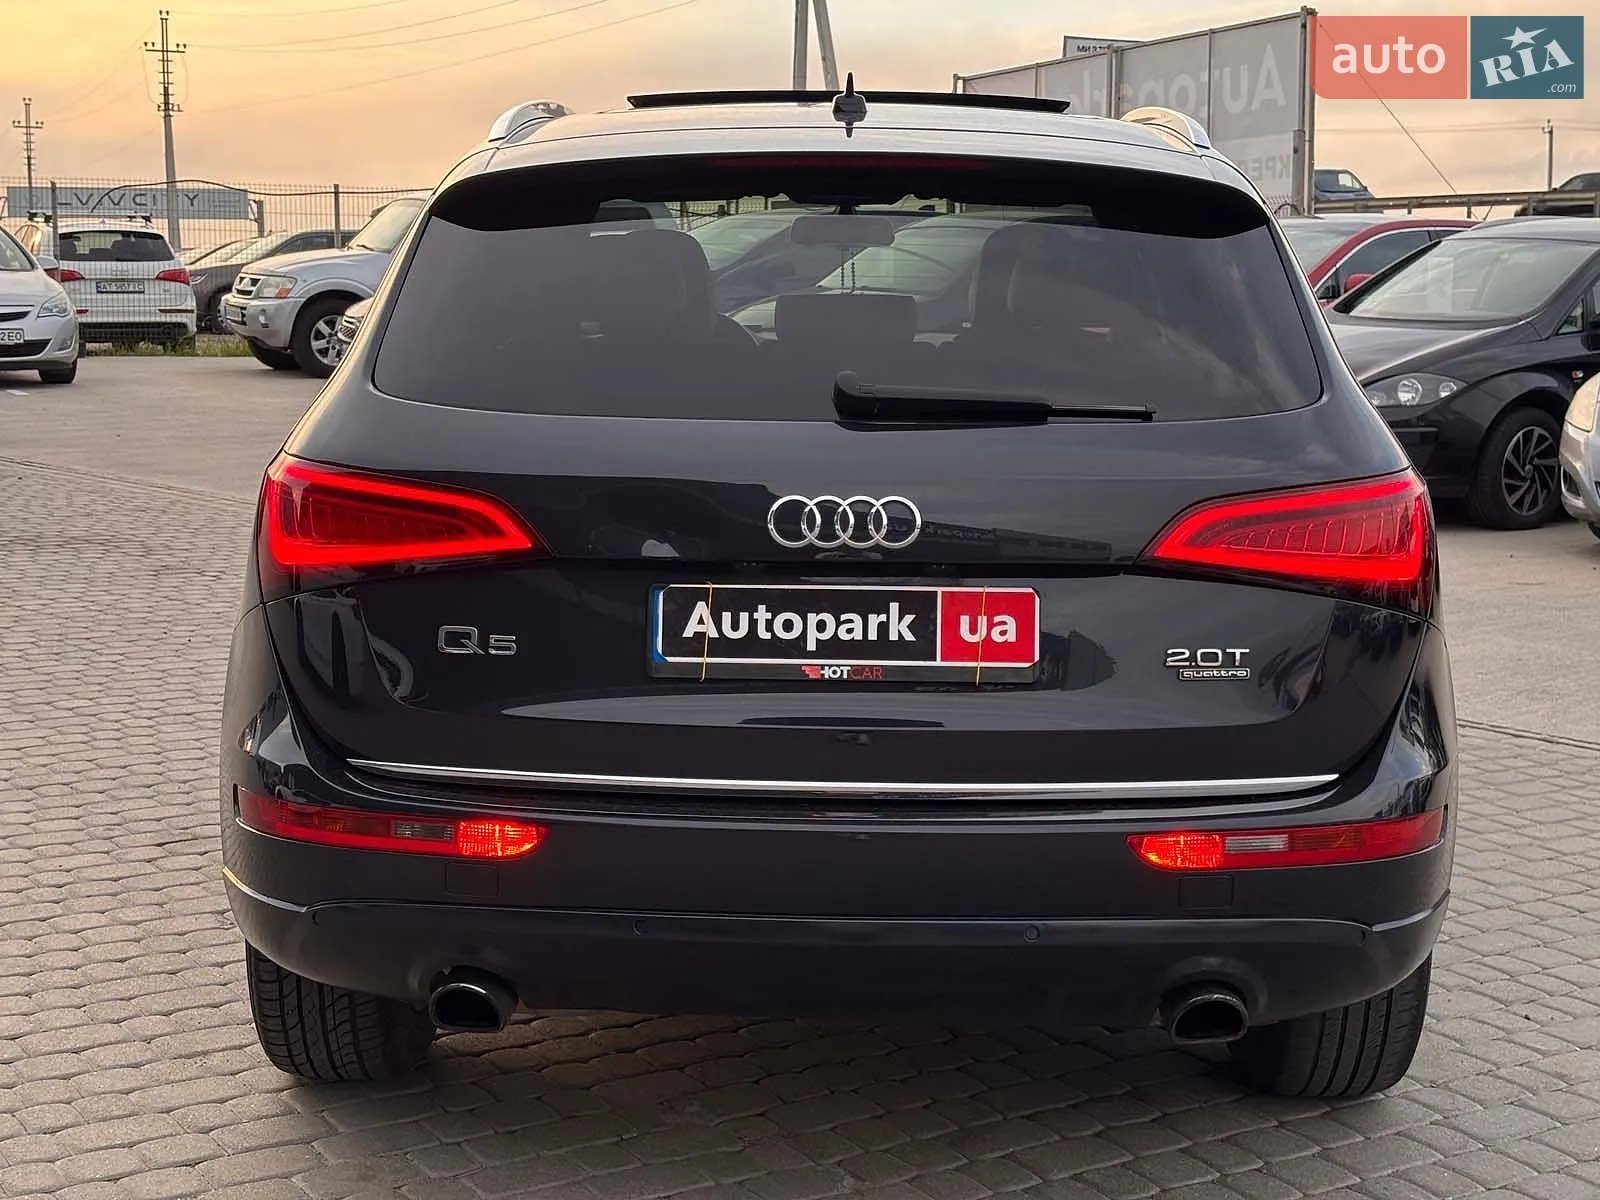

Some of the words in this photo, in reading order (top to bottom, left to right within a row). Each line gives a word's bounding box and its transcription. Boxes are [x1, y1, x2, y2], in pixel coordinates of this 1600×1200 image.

[682, 601, 917, 652] Autopark
[958, 614, 1017, 643] ua
[1165, 648, 1250, 667] 2.0T
[1183, 670, 1247, 679] quattro
